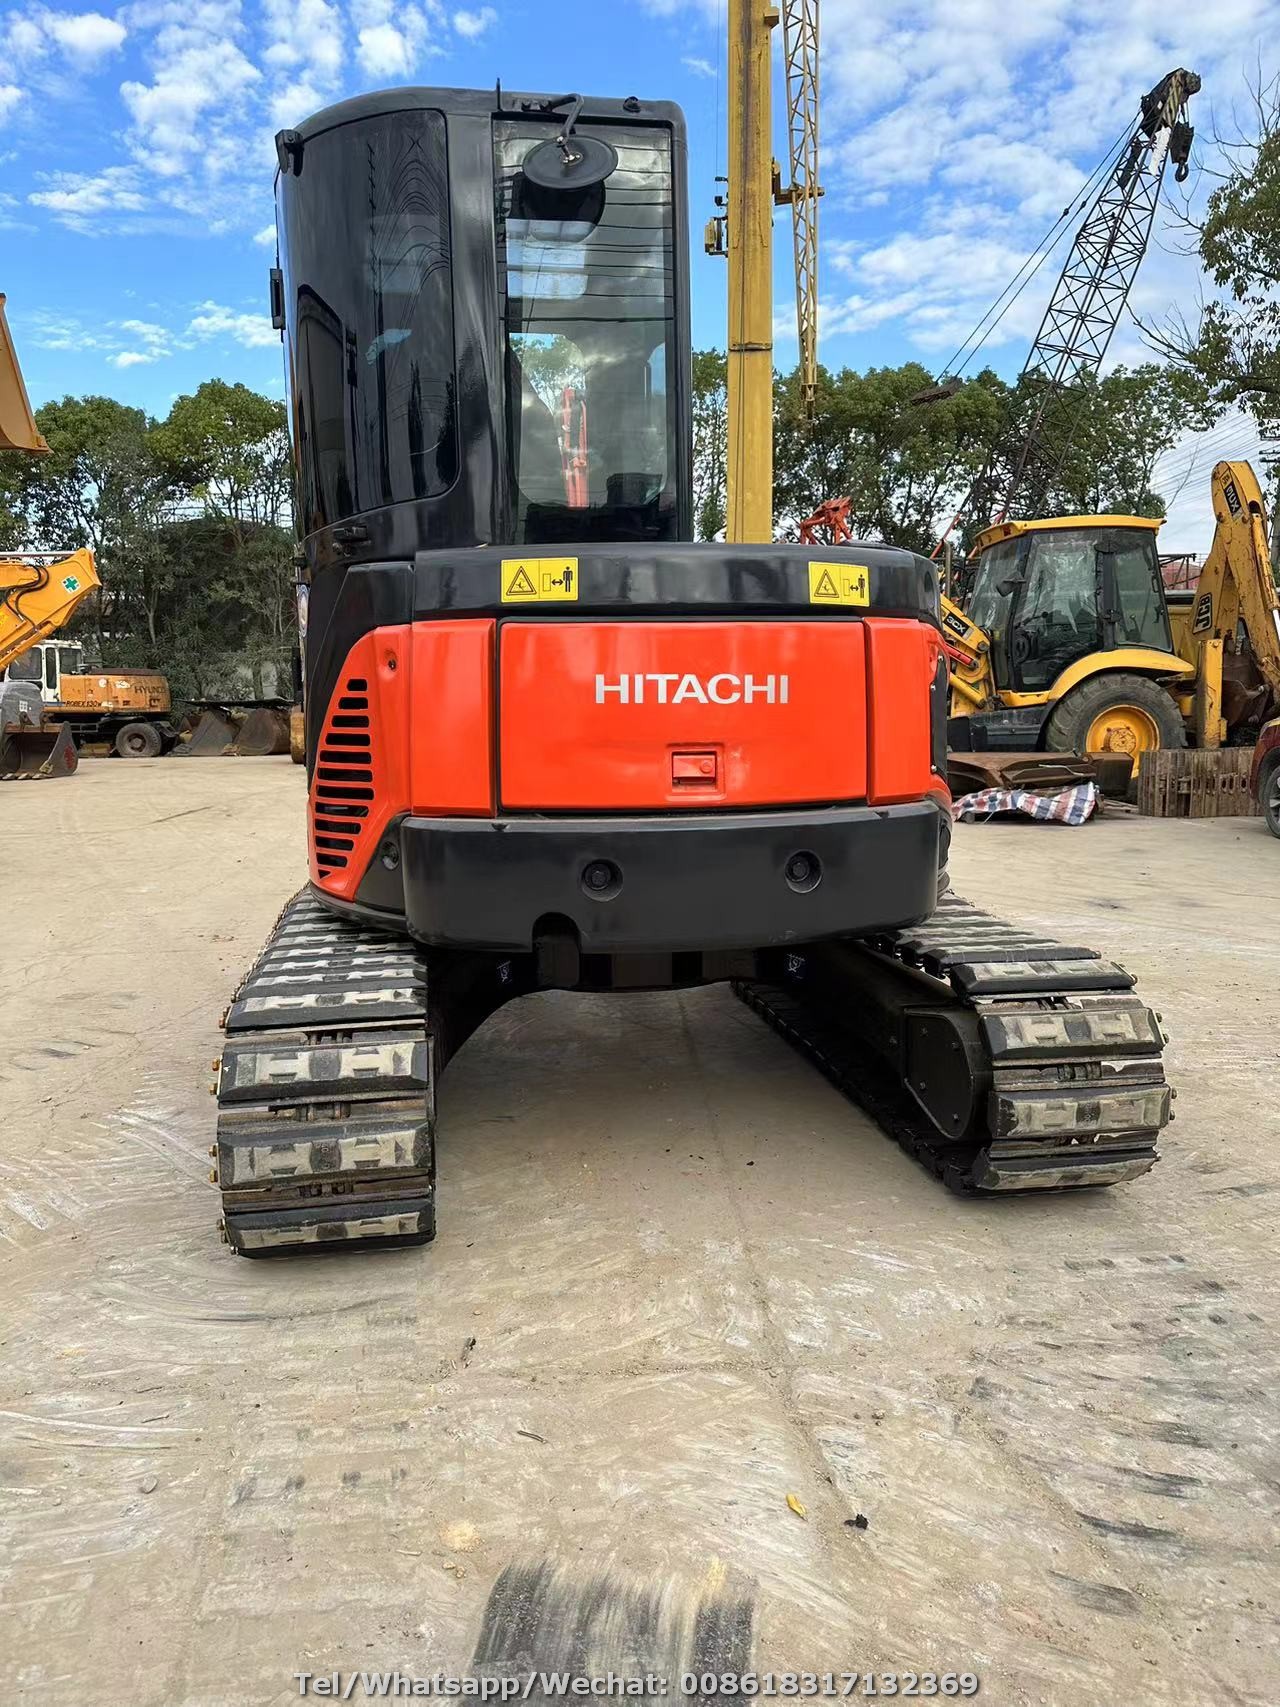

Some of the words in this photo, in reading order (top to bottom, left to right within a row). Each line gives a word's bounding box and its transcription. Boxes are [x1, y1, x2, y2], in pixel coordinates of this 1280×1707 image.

[946, 615, 966, 633] 3CX
[1194, 594, 1211, 630] JCB
[595, 673, 789, 704] HITACHI
